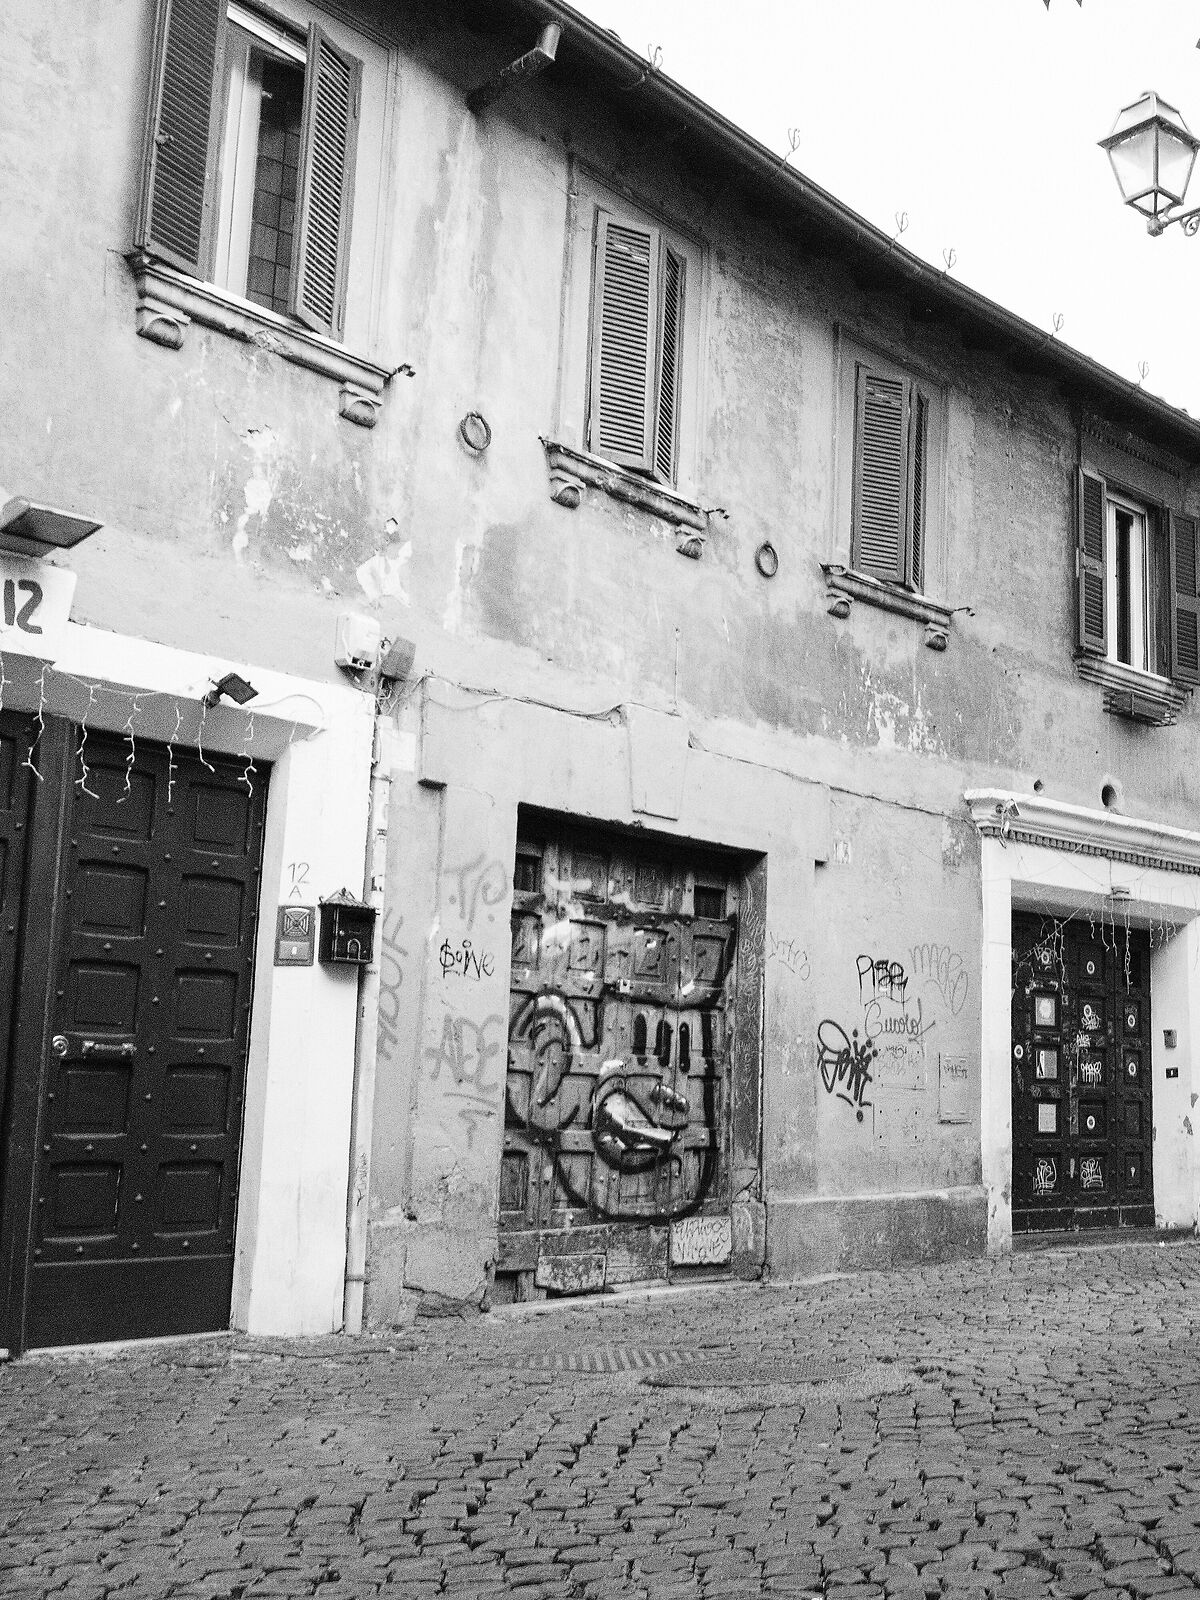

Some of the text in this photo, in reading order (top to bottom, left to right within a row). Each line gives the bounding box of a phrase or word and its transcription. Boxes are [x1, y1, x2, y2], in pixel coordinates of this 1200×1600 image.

[3, 578, 44, 635] 12
[287, 862, 311, 884] 12
[288, 885, 302, 899] A
